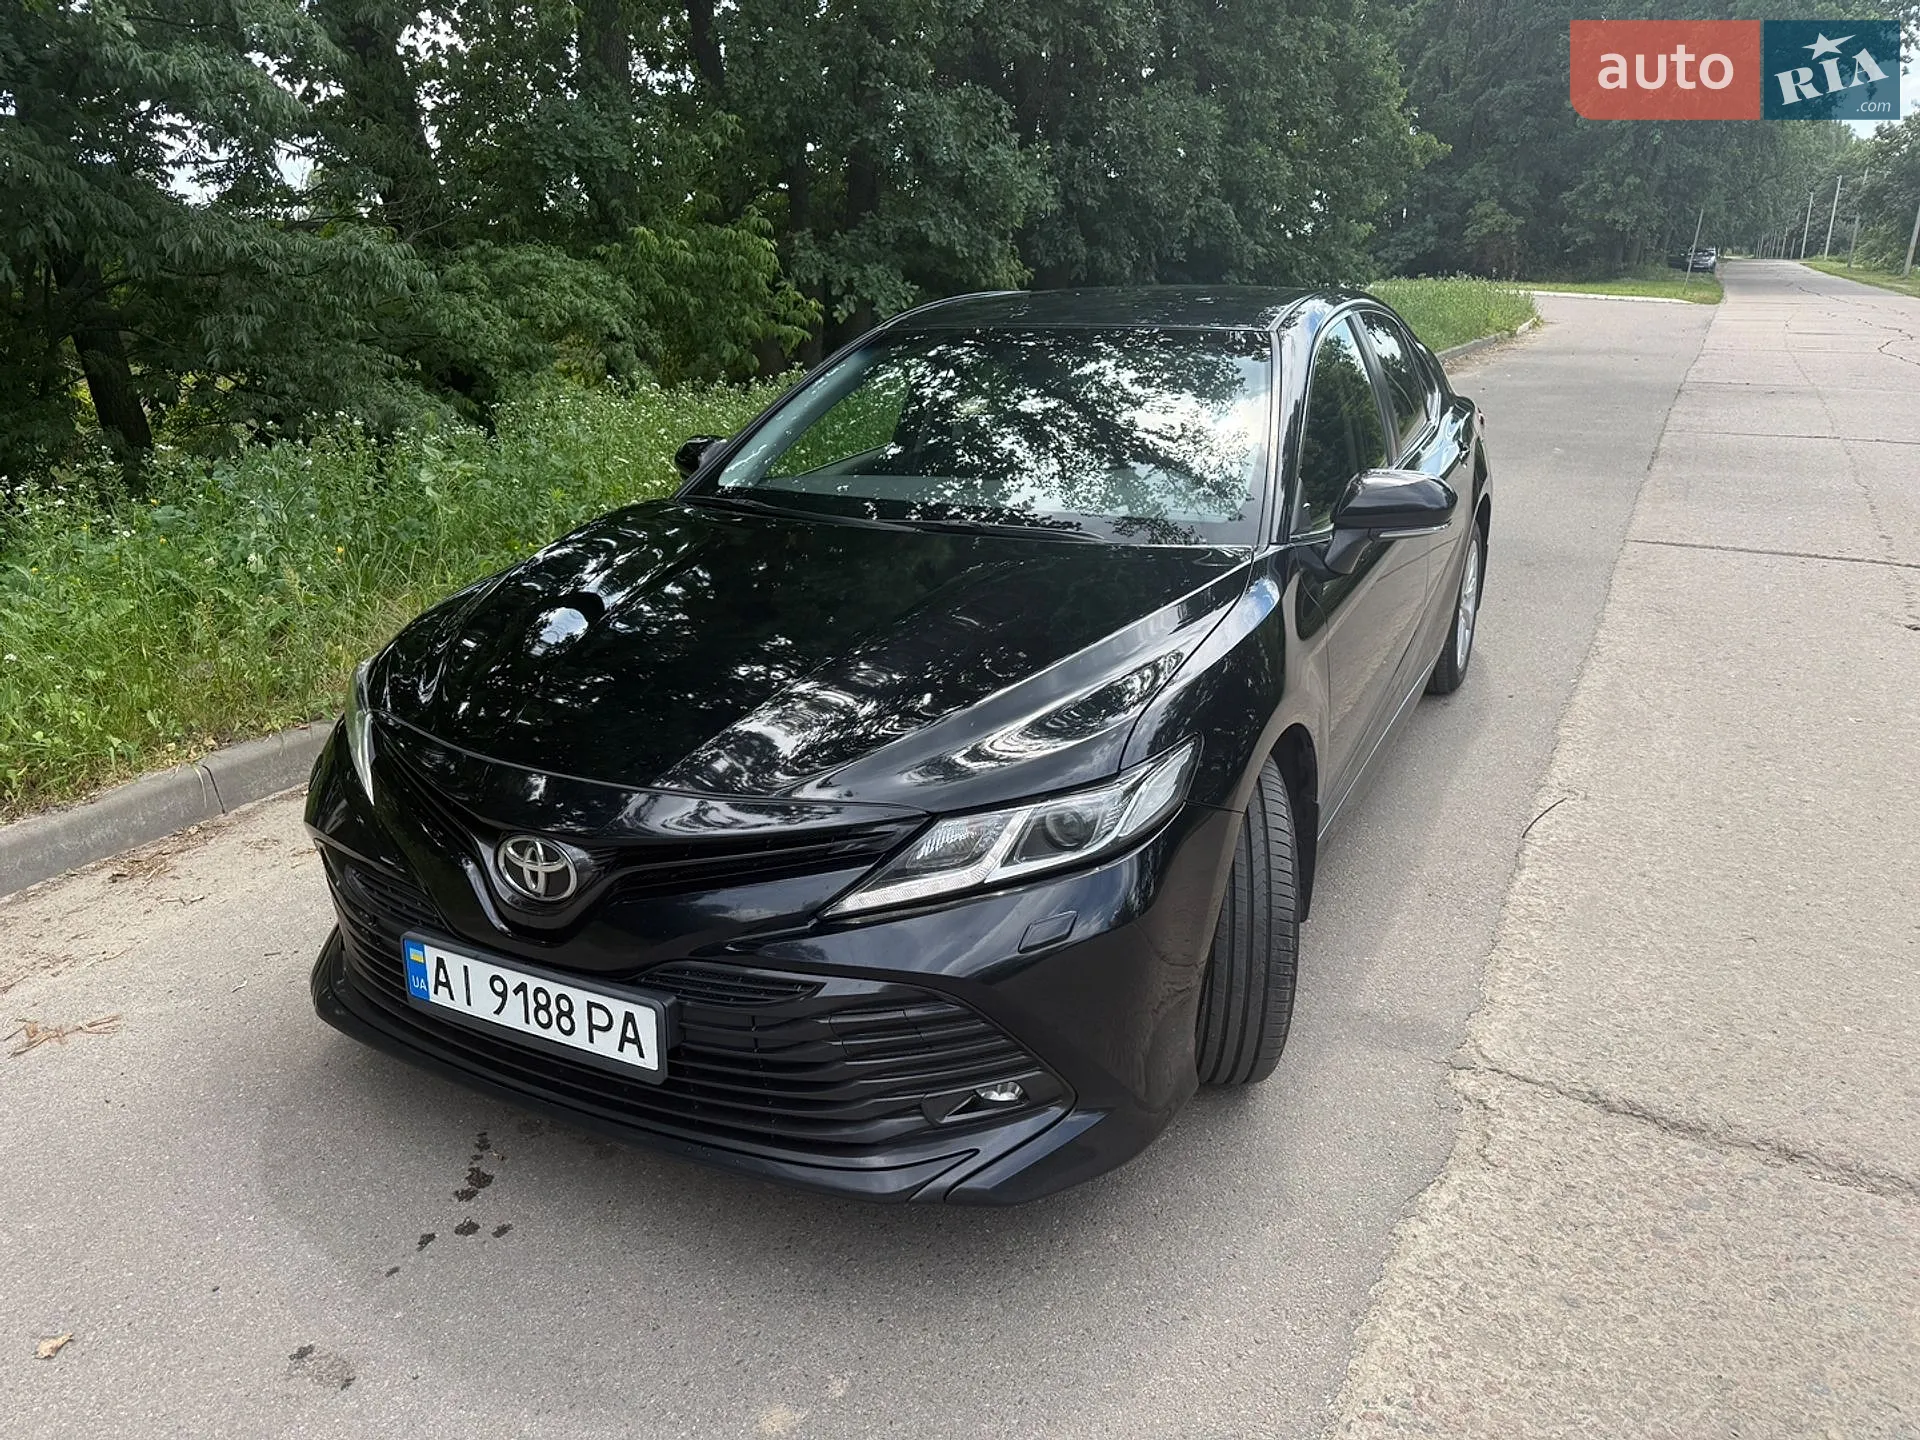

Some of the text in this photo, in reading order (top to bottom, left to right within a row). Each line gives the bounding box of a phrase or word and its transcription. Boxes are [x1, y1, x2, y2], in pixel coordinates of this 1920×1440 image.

[413, 976, 427, 991] UA
[433, 956, 645, 1059] AI 9188 PA
